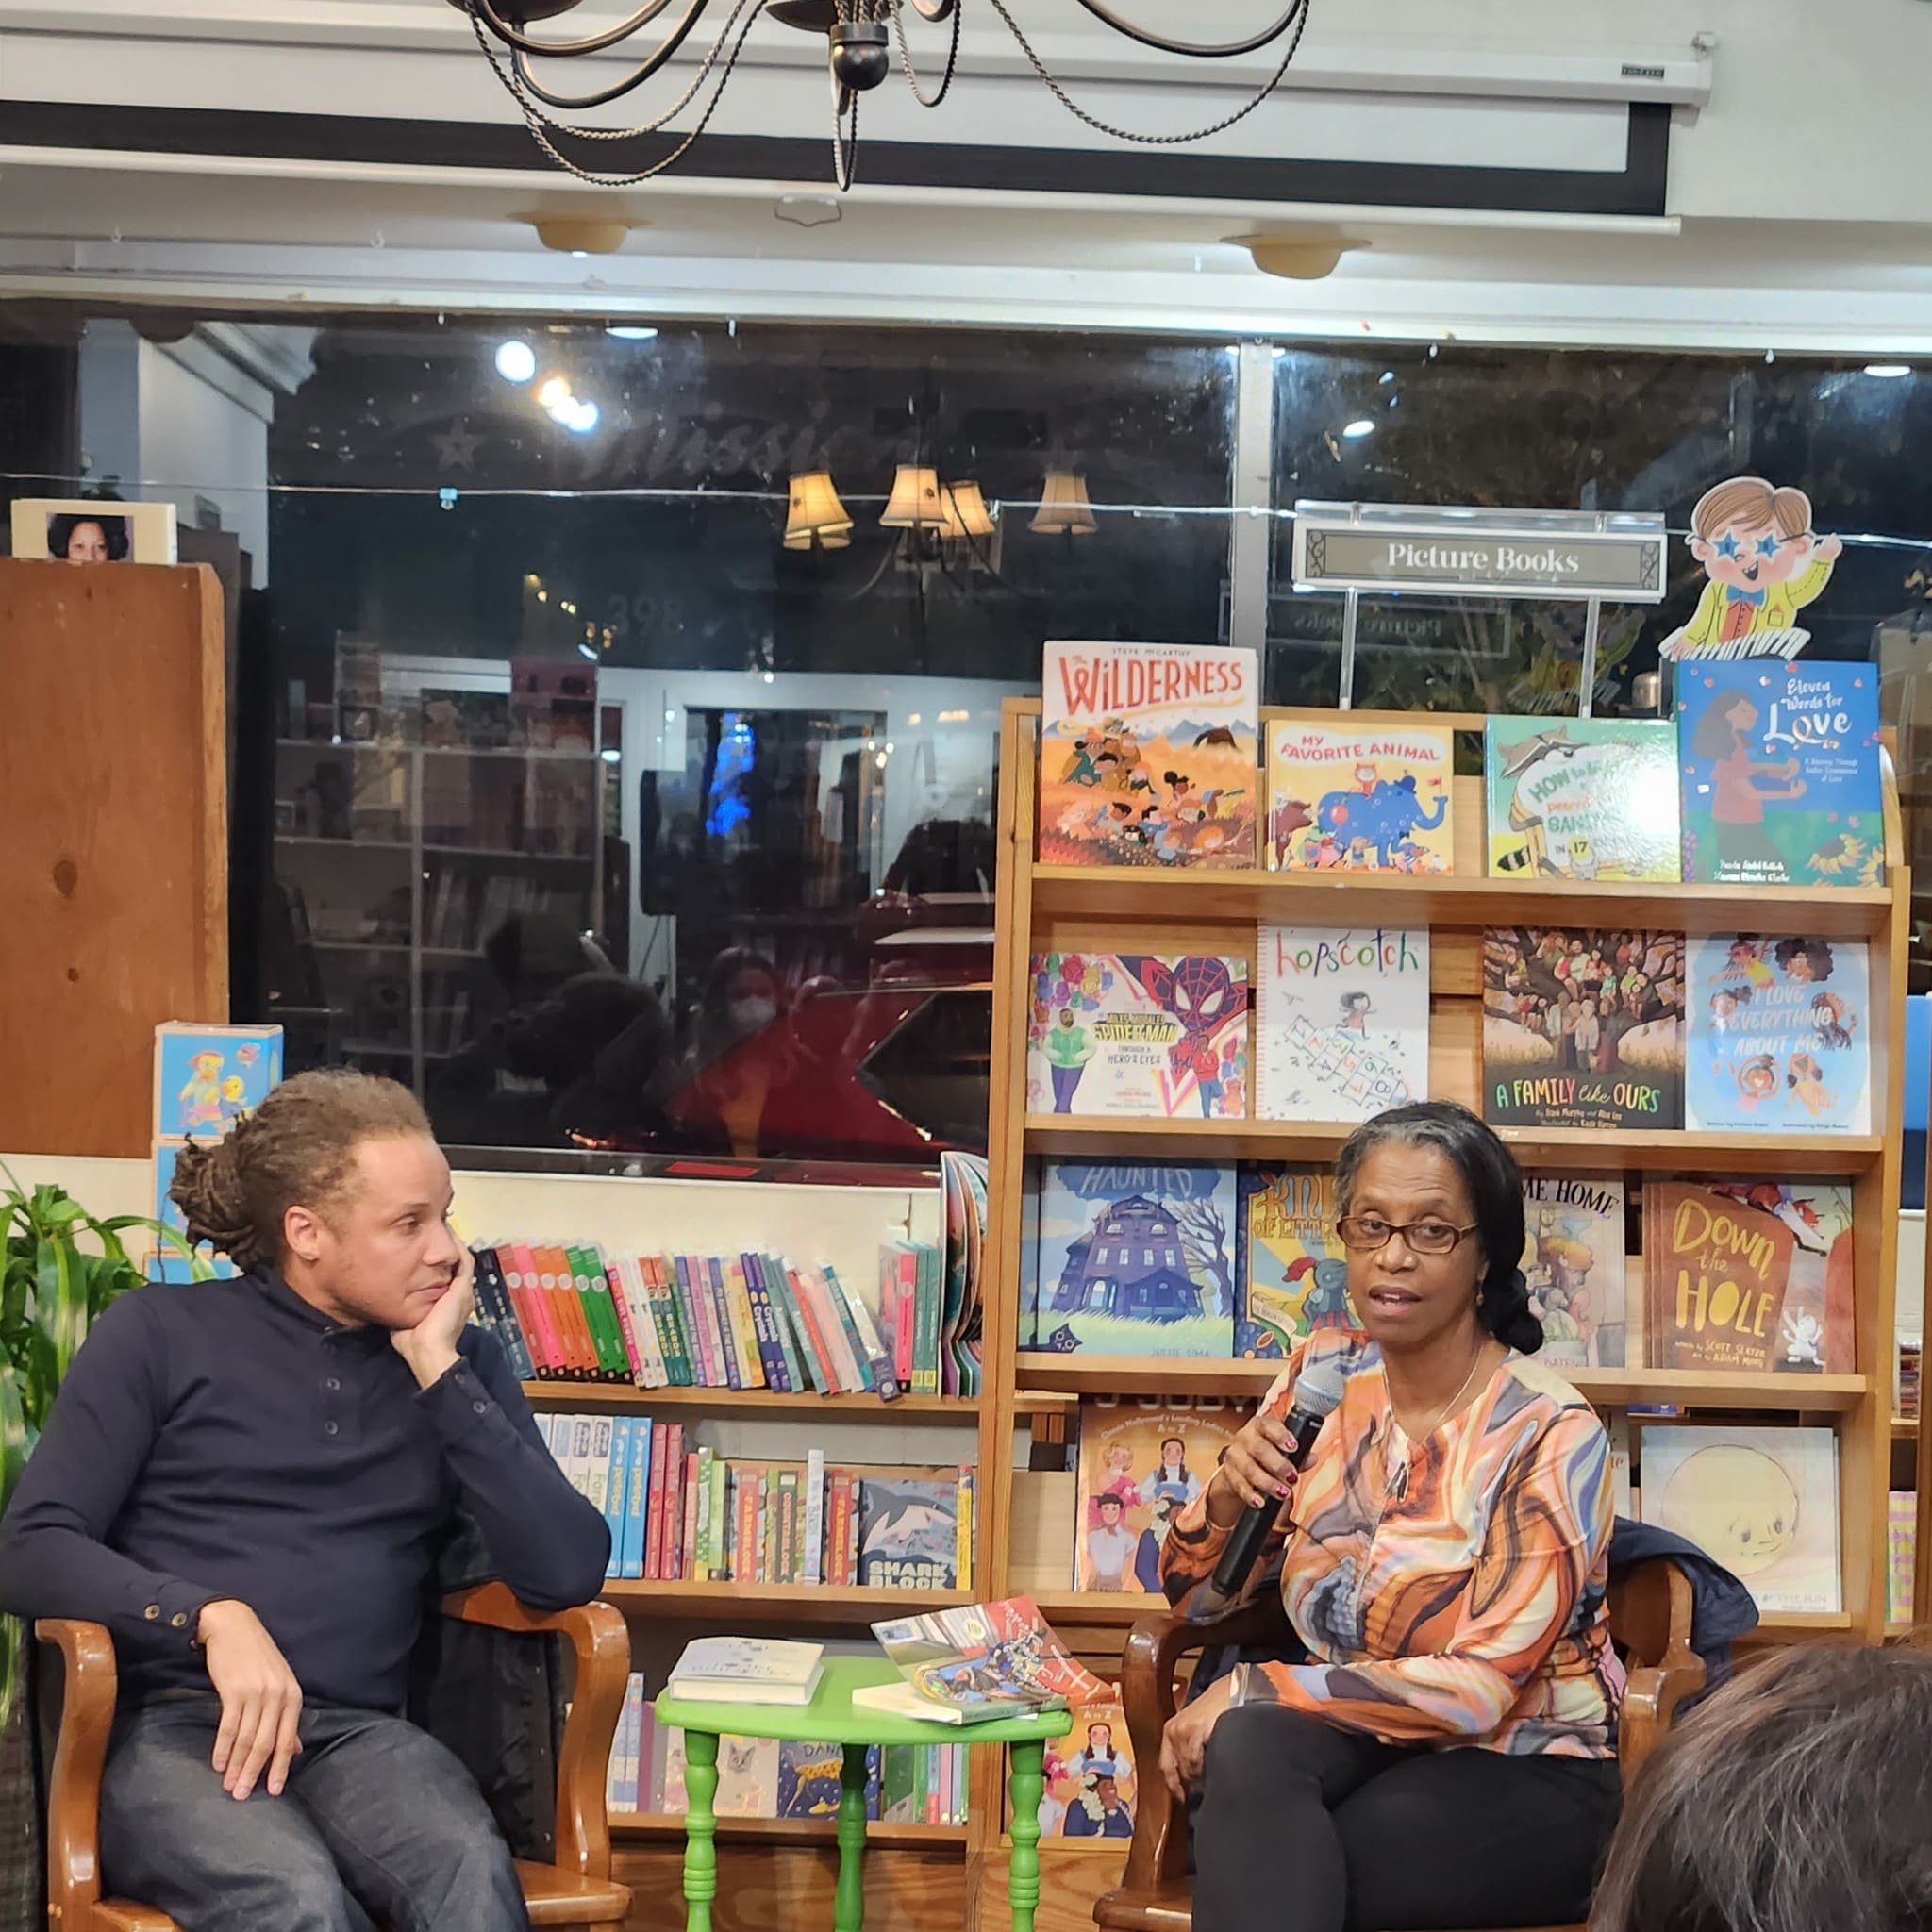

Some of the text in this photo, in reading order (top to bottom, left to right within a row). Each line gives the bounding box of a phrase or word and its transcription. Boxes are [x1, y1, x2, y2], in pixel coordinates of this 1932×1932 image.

[1389, 543, 1579, 572] Picture Books
[1787, 678, 1830, 695] Eleven
[1780, 696, 1823, 710] Words
[1763, 702, 1852, 744] Love
[1281, 742, 1440, 761] FAVORITE ANIMAL
[1302, 736, 1324, 746] MY
[1528, 768, 1571, 802] HOW
[1574, 841, 1588, 854] 17
[1275, 928, 1419, 977] hopscotch
[1766, 985, 1804, 1006] LOVE
[1730, 1006, 1832, 1031] EVERYTHING
[1093, 1024, 1176, 1042] SPIDER-MAN
[1735, 1035, 1789, 1057] ABOUT
[1108, 1054, 1160, 1065] HERO'S EYES
[1496, 1077, 1661, 1113] A FAMILY like OURS
[1081, 1165, 1193, 1197] HAUNTED
[1556, 1180, 1620, 1221] HOME
[1695, 1248, 1729, 1273] the
[1676, 1270, 1775, 1338] HOLE
[754, 1306, 770, 1342] Crystals
[764, 1305, 780, 1342] Crystals
[1705, 1340, 1731, 1352] SCOTT
[1736, 1343, 1766, 1357] SLATER
[592, 1474, 606, 1506] Fore
[869, 1560, 949, 1576] SHARK
